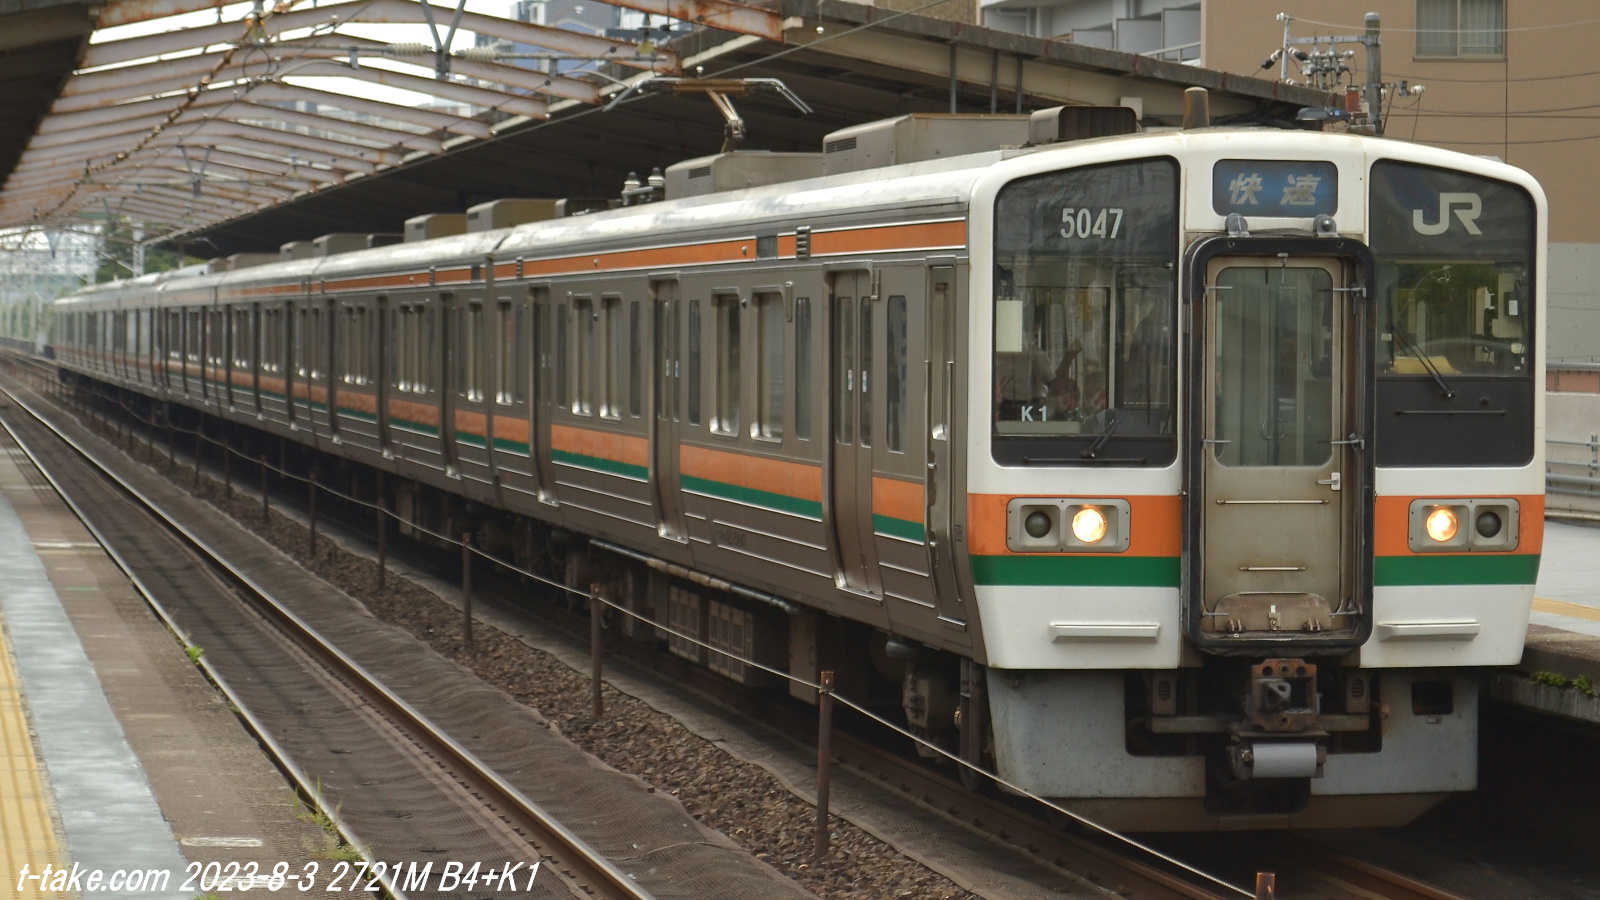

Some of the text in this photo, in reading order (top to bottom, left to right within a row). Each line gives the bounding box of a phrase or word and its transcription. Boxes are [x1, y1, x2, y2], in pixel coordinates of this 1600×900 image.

[1229, 173, 1322, 205] 快速
[1060, 207, 1124, 239] 5047
[1413, 193, 1482, 235] JR
[1021, 405, 1047, 422] K1
